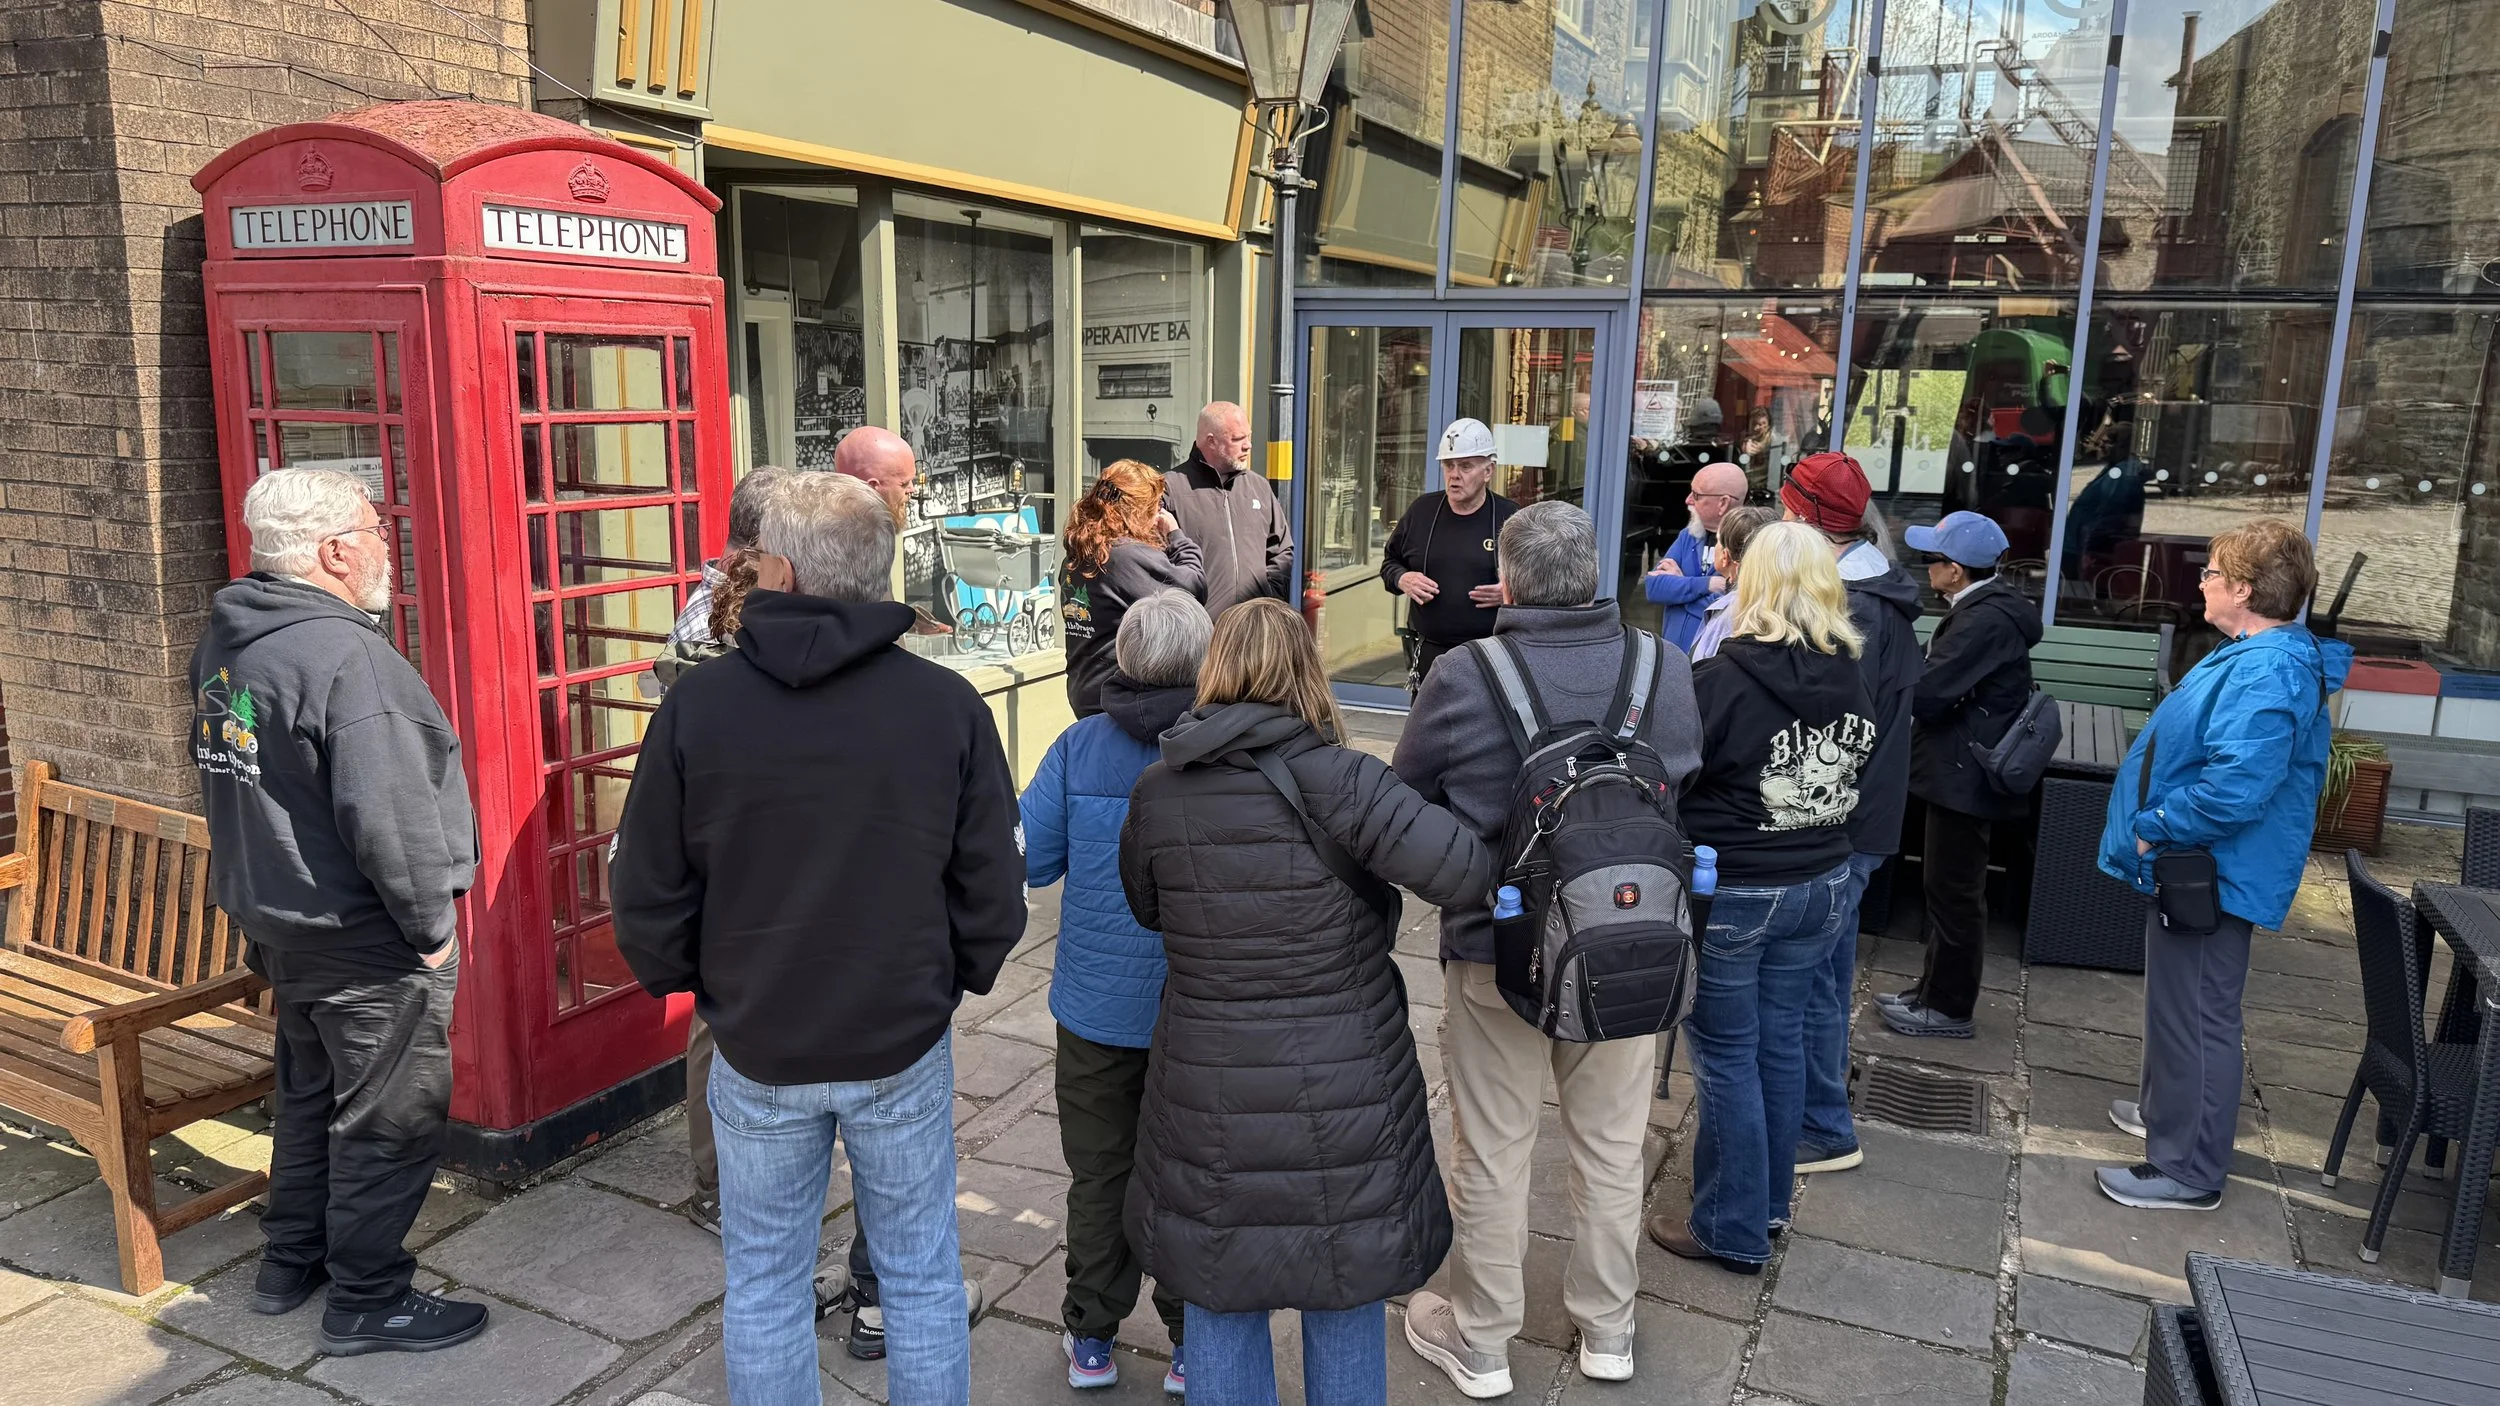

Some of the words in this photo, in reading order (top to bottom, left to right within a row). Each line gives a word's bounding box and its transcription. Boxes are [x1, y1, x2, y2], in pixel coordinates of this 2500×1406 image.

[239, 205, 409, 244] TELEPHONE
[487, 208, 678, 257] TELEPHONE
[1082, 323, 1160, 346] PERATIVE
[1167, 321, 1191, 341] BA
